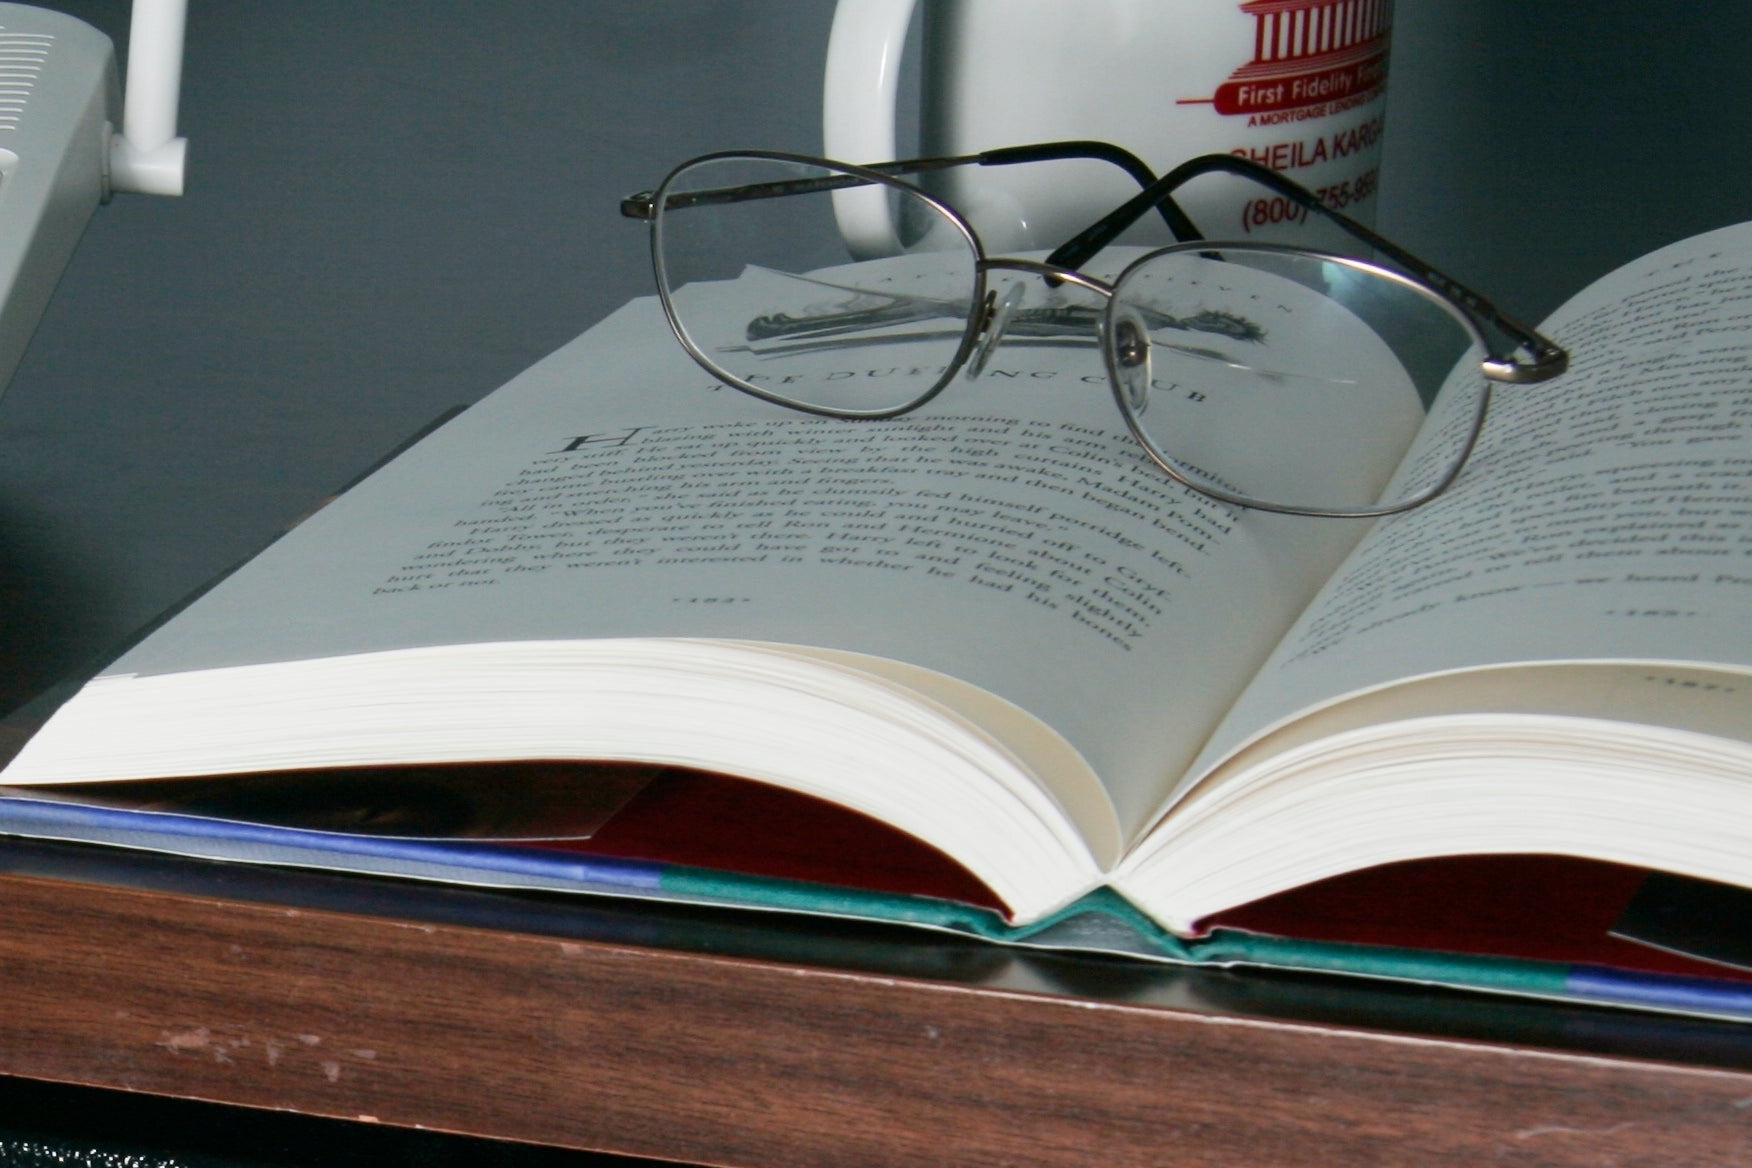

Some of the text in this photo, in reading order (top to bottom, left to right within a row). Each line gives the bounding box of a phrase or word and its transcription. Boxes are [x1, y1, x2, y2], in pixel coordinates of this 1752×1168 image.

[1237, 83, 1285, 107] First
[1292, 70, 1352, 100] Fidelity
[1248, 115, 1259, 128] A
[1260, 104, 1328, 126] MORTGAGE
[1241, 196, 1309, 234] (800)
[826, 367, 1061, 383] DUELNG
[1079, 374, 1208, 402] CUB
[924, 416, 1021, 426] morning
[882, 434, 959, 442] looked
[949, 446, 1000, 457] high
[1076, 476, 1162, 512] Madam
[898, 524, 1017, 549] Hermione
